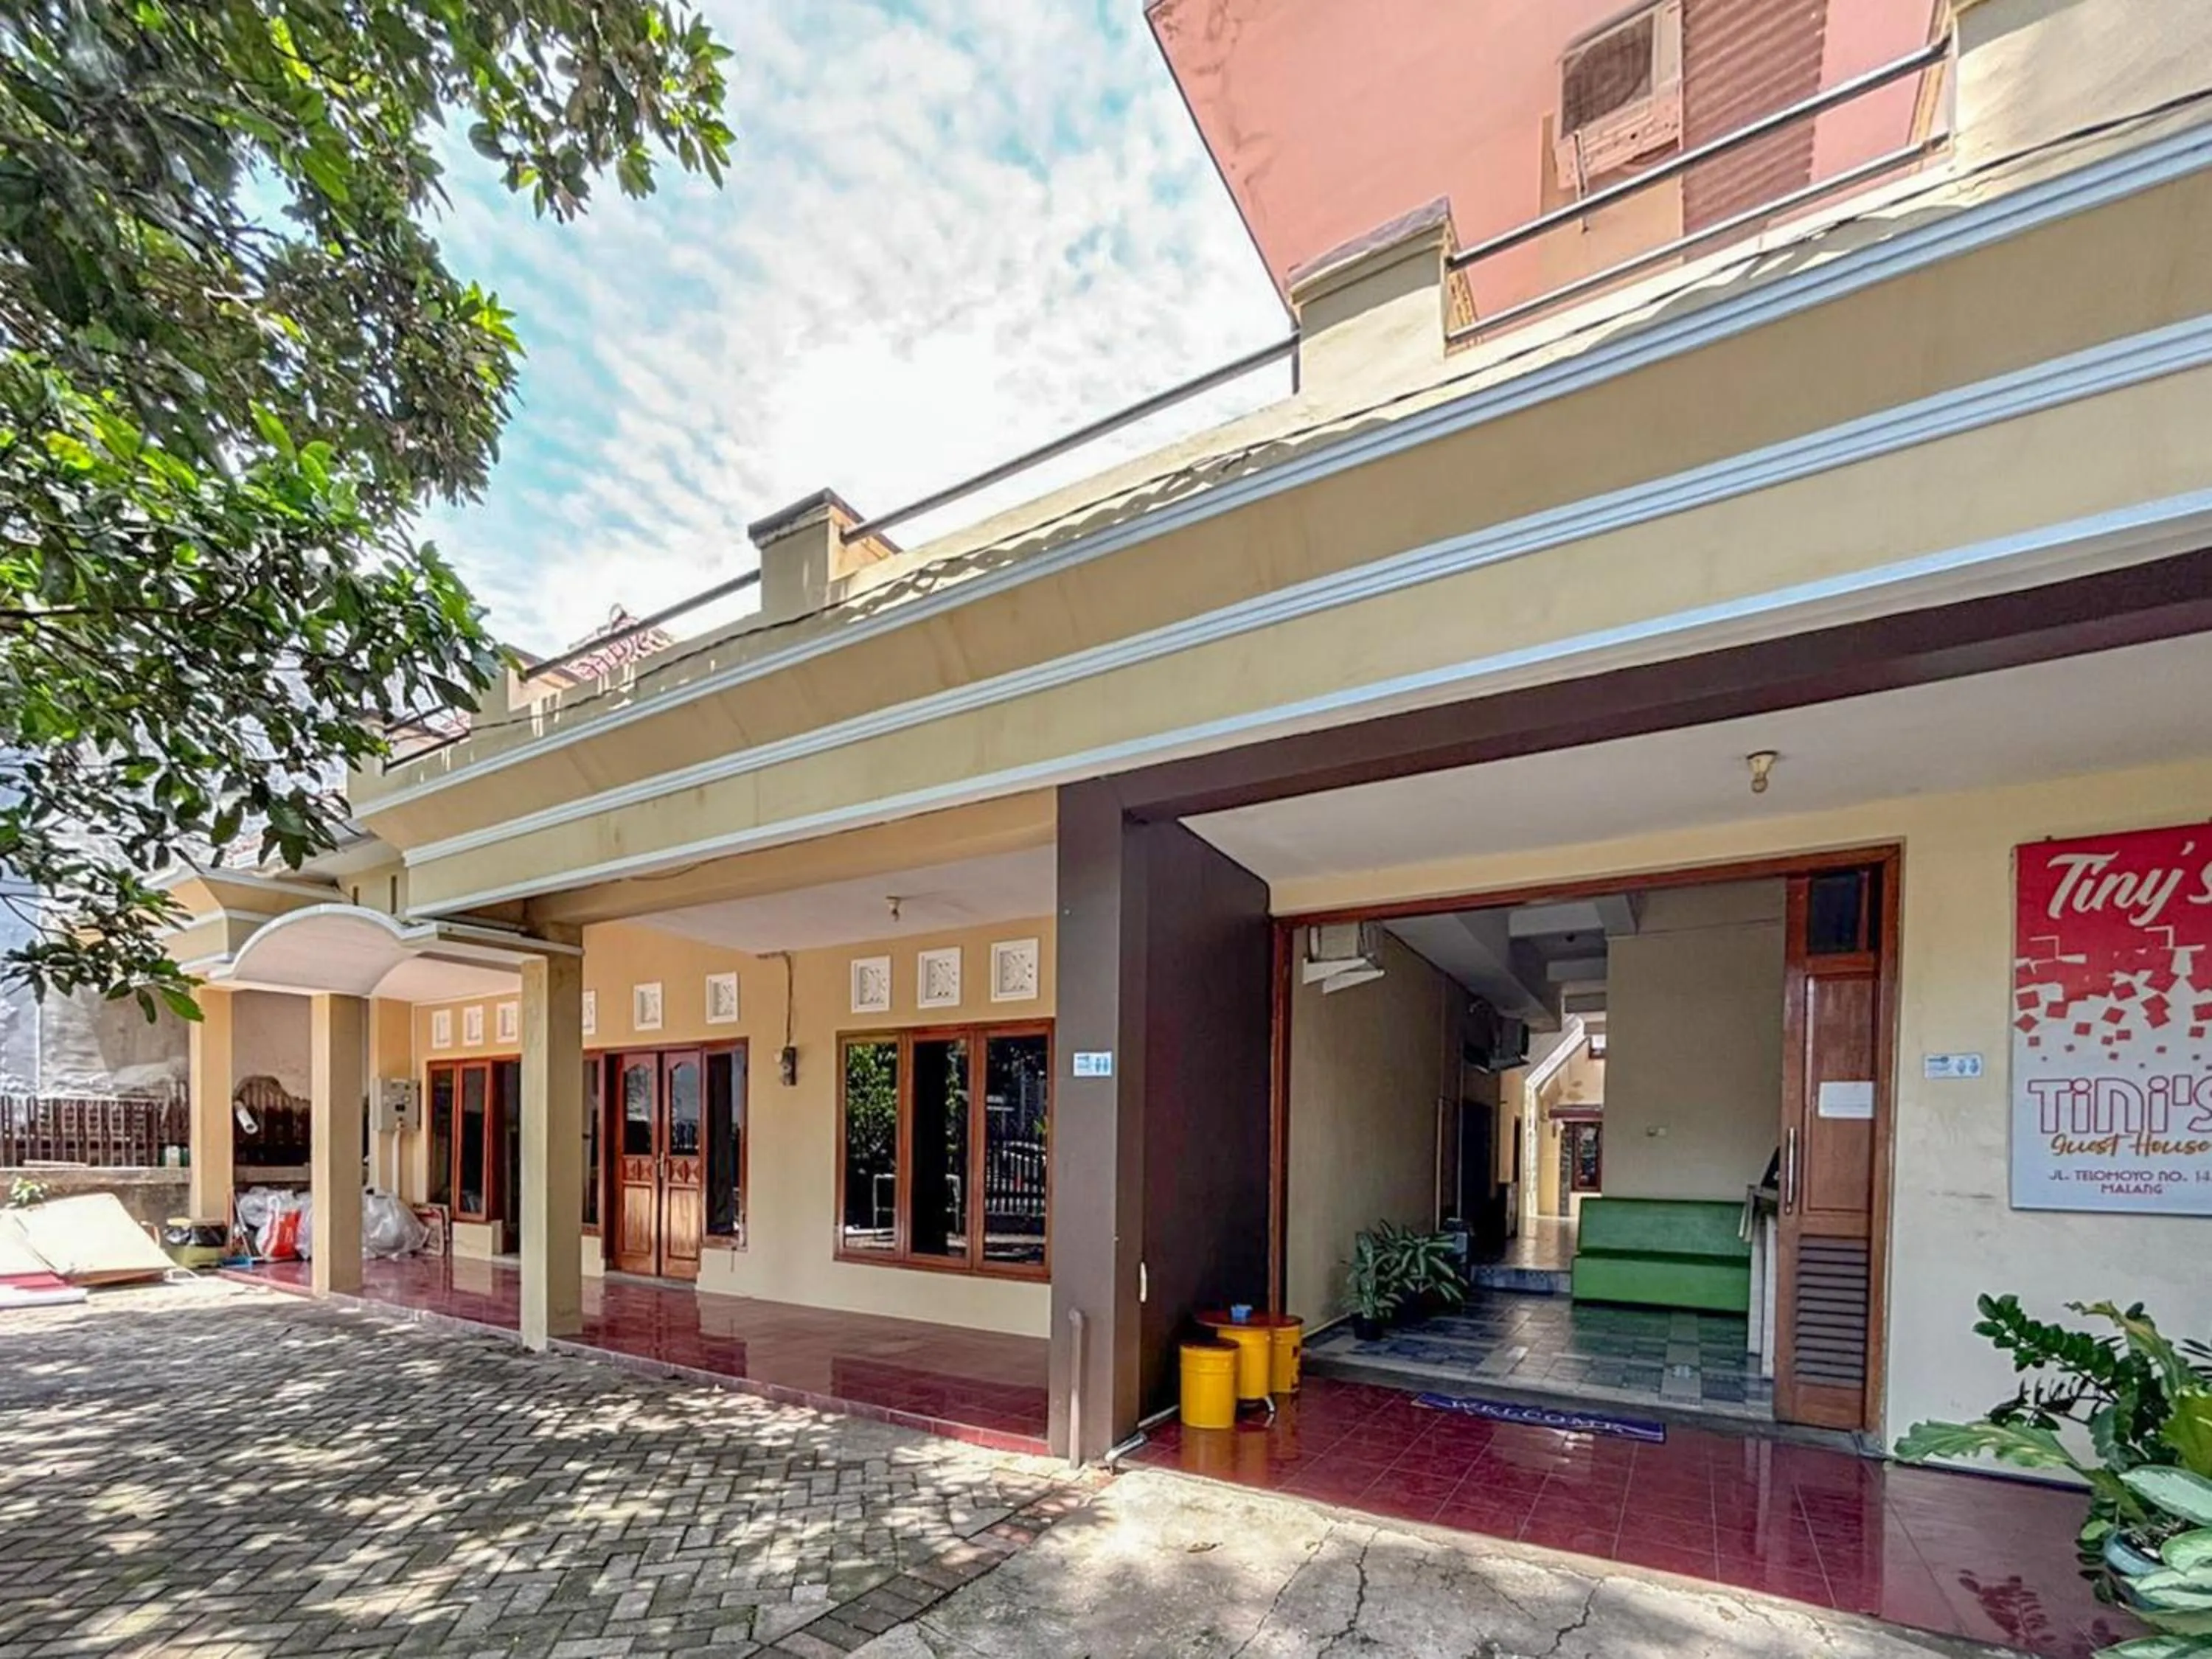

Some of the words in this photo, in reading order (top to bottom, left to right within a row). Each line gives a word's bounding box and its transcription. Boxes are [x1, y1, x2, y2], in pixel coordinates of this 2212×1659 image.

[2046, 841, 2212, 926] Tiny's
[2129, 1130, 2211, 1157] House
[2075, 1170, 2154, 1182] TELOMOYO
[2101, 1183, 2163, 1194] MALANG
[1450, 1399, 1624, 1434] WELCOME
